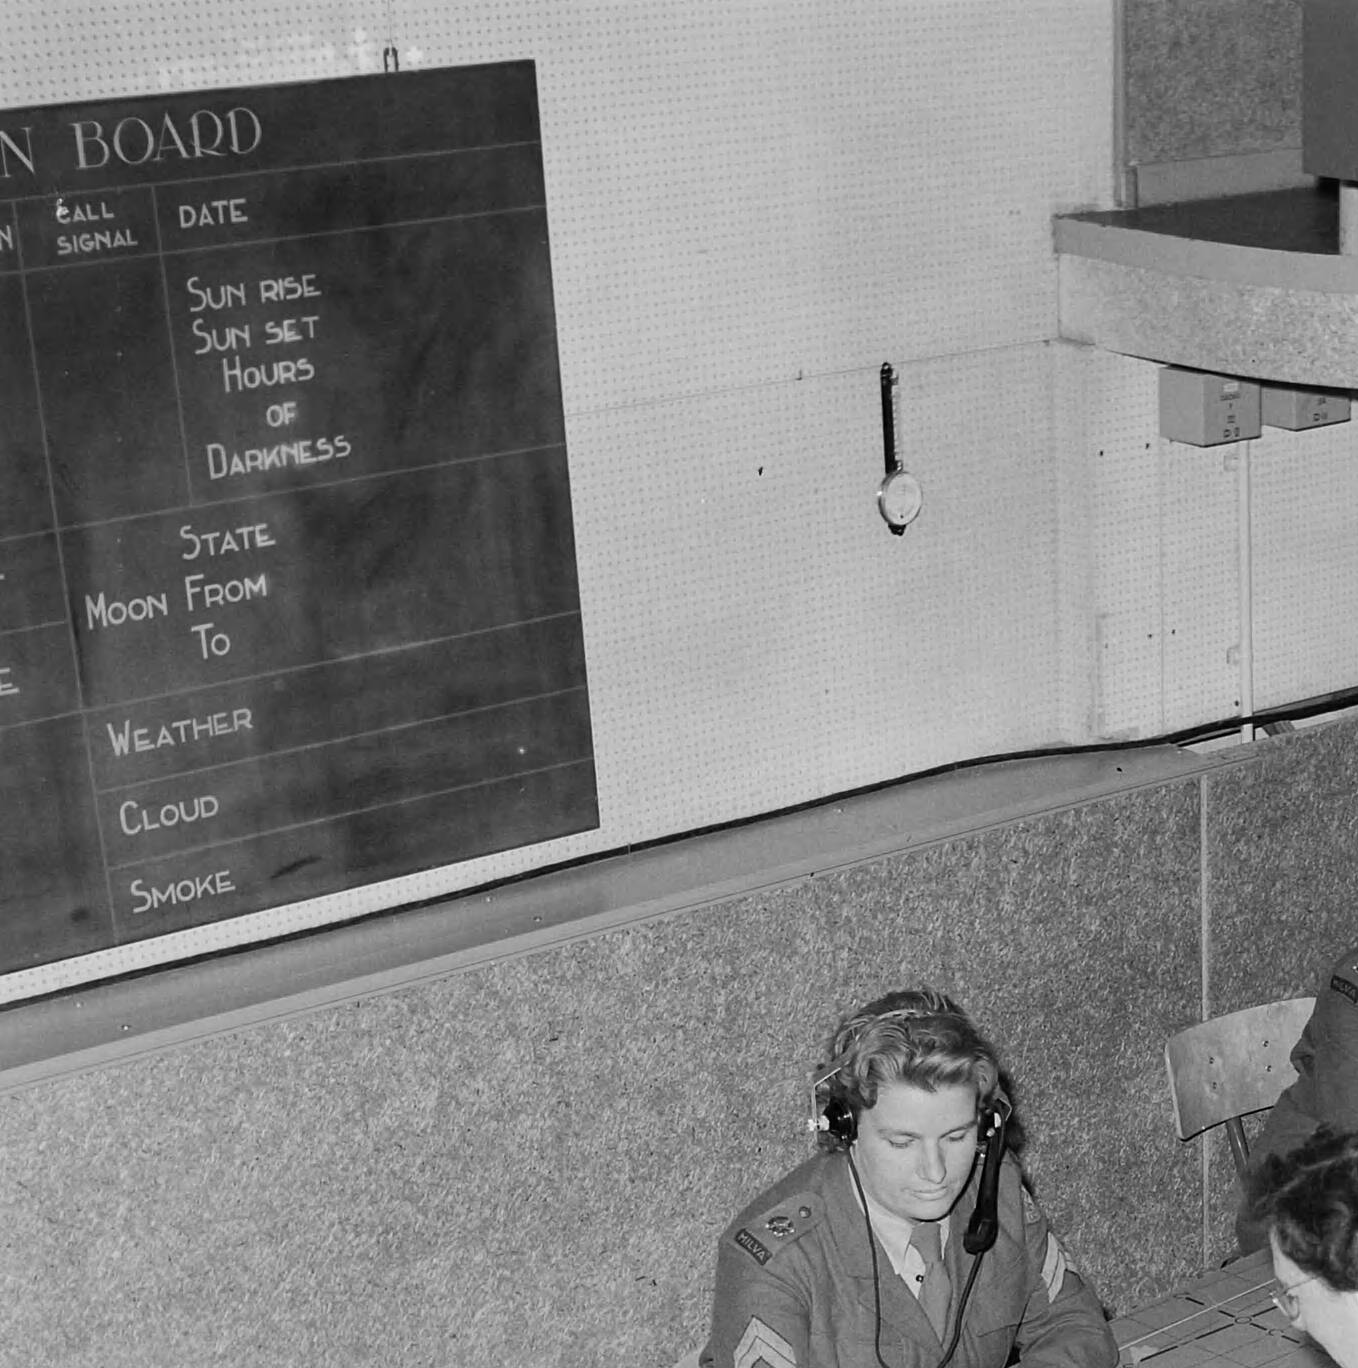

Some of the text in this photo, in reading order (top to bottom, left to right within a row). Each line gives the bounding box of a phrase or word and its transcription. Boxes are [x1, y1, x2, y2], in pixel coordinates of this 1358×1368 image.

[69, 107, 262, 169] BOARD
[56, 200, 115, 224] CALL
[179, 198, 248, 229] DATE
[57, 229, 138, 255] SIGNAL
[187, 274, 322, 312] SUN RISE
[192, 316, 320, 355] SUN SET
[223, 355, 315, 393] HOURS
[266, 401, 296, 427] OF
[206, 435, 351, 480] DARKNESS
[179, 523, 276, 560] STATE
[85, 574, 268, 630] MOON FROM
[191, 622, 231, 660] TO
[106, 708, 253, 757] WEATHER
[119, 795, 219, 835] CLOUD
[130, 869, 236, 914] SMOKE
[739, 1233, 765, 1260] MILVA
